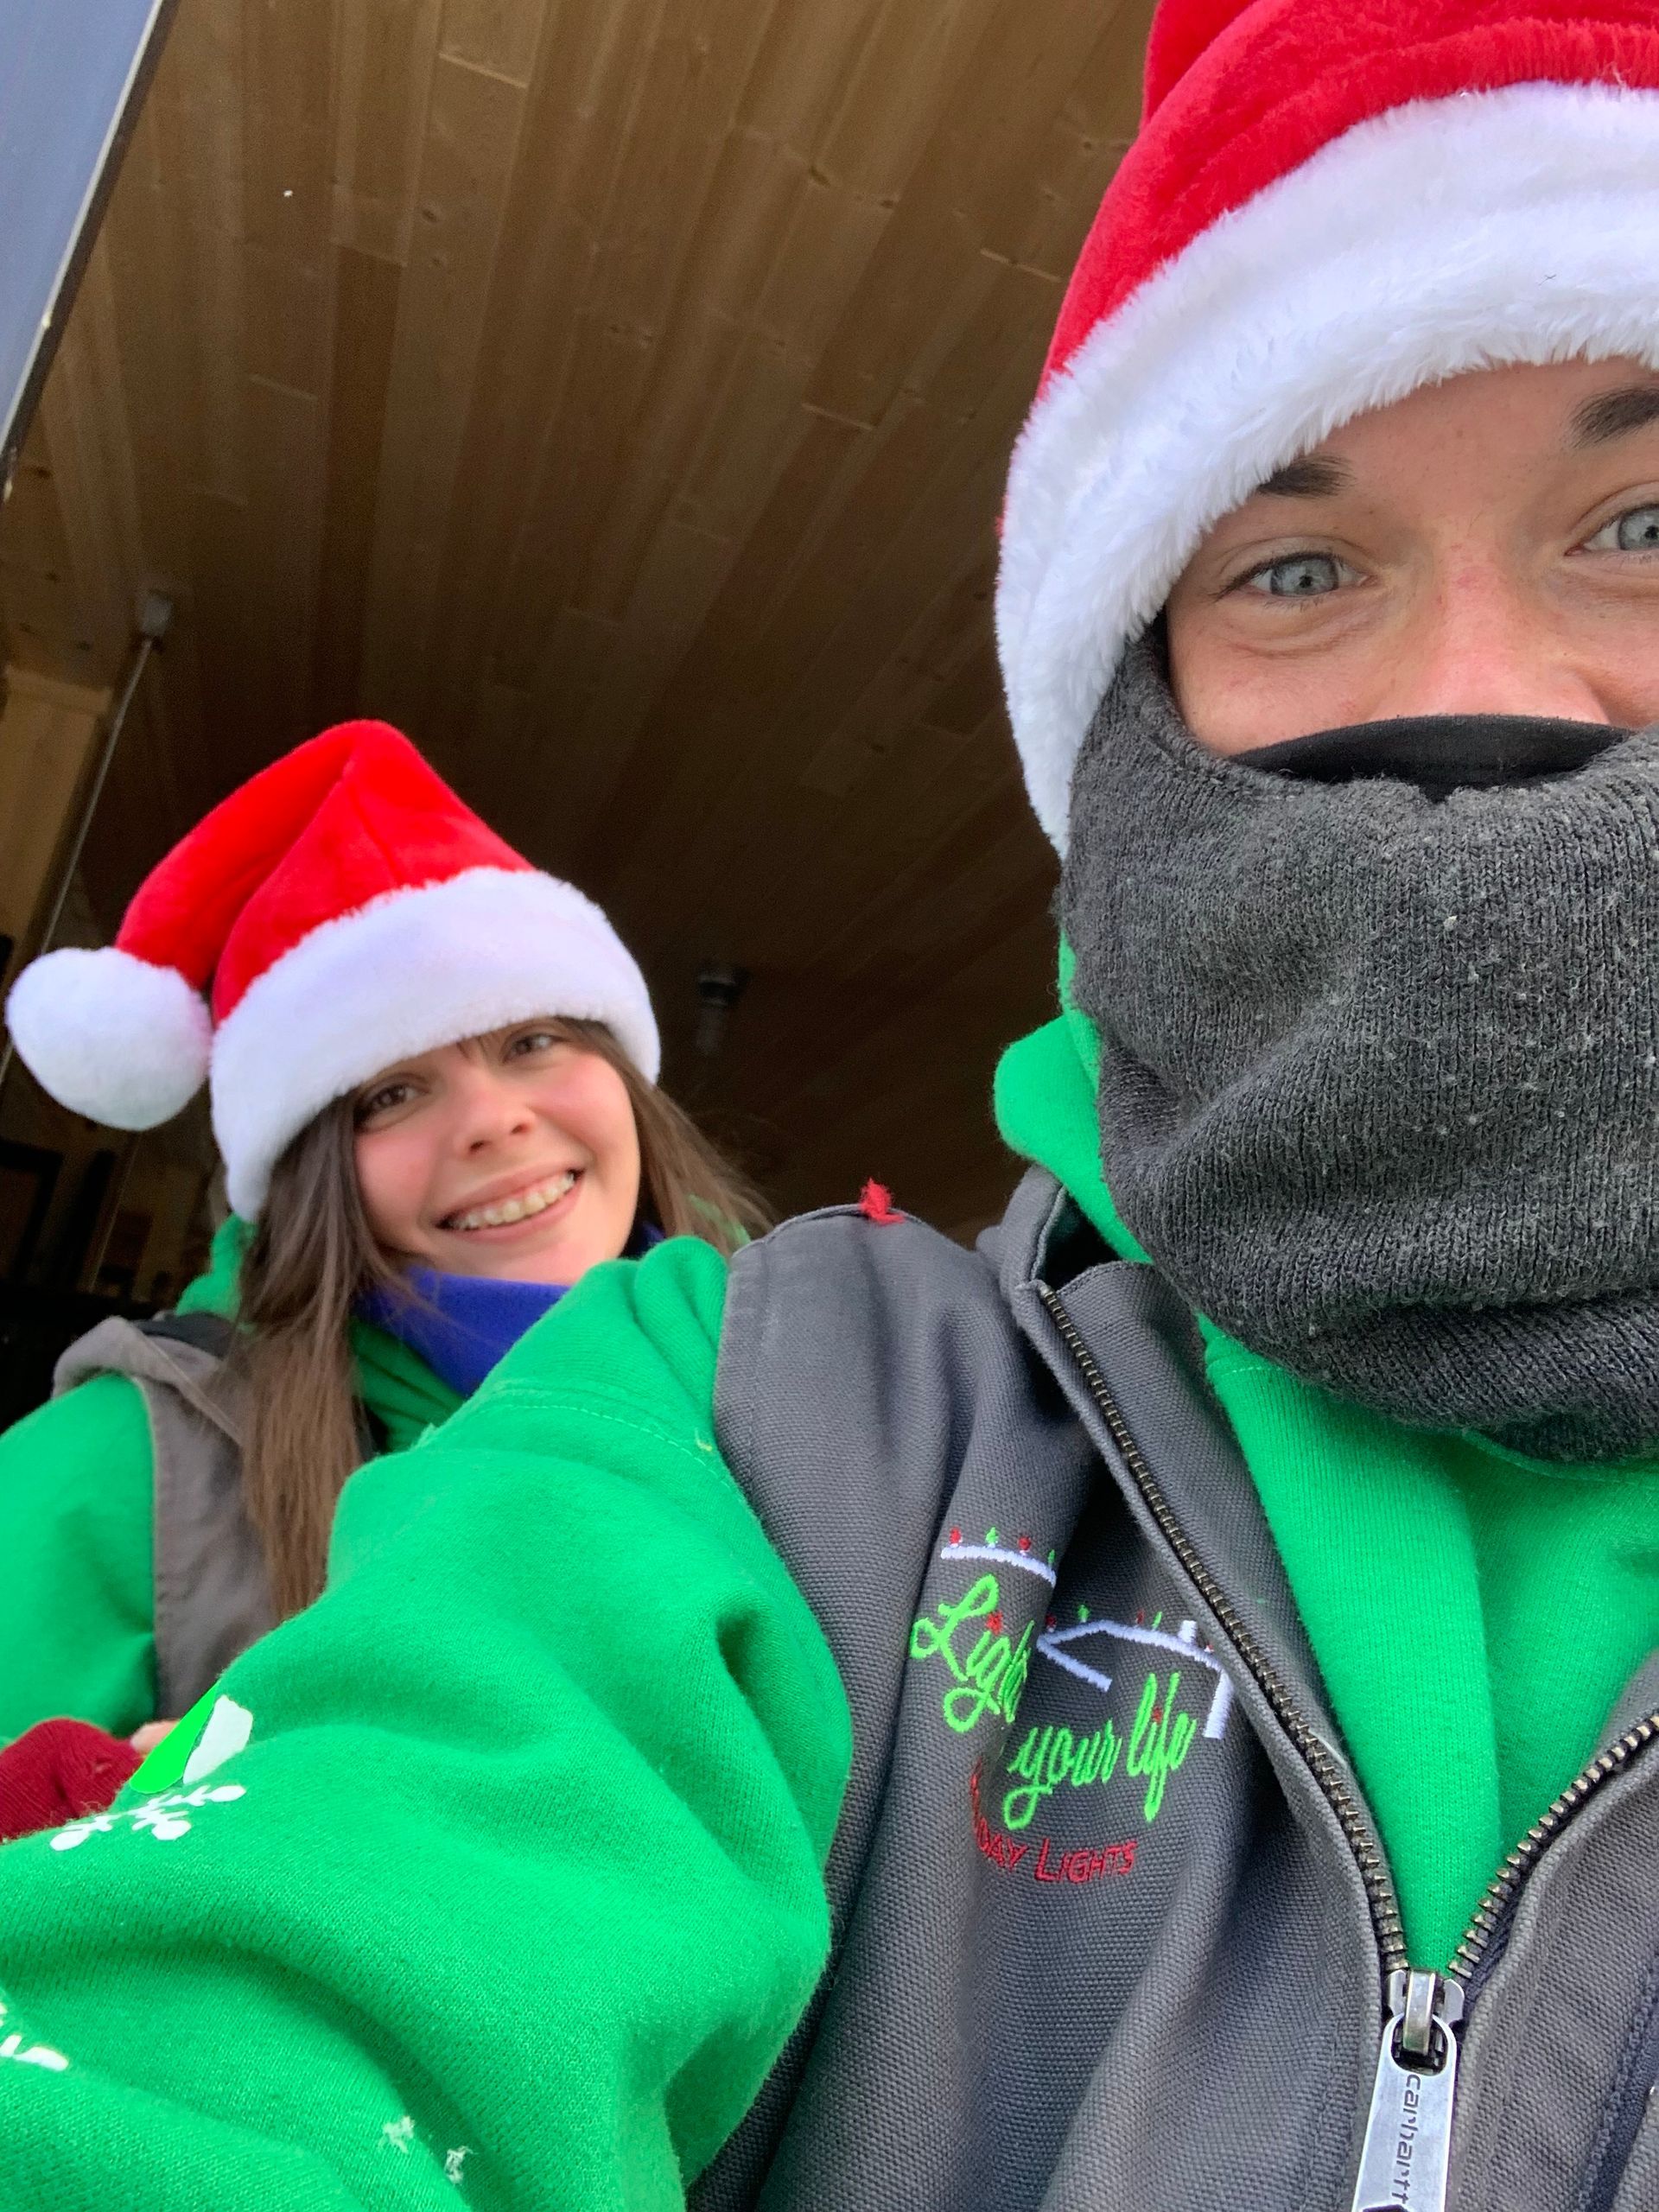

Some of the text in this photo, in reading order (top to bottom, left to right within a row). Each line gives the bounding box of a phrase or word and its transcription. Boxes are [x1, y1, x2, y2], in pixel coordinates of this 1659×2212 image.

[910, 1573, 1034, 1733] Ligh
[1003, 1671, 1198, 1830] your life
[1391, 2073, 1421, 2205] carhartt
